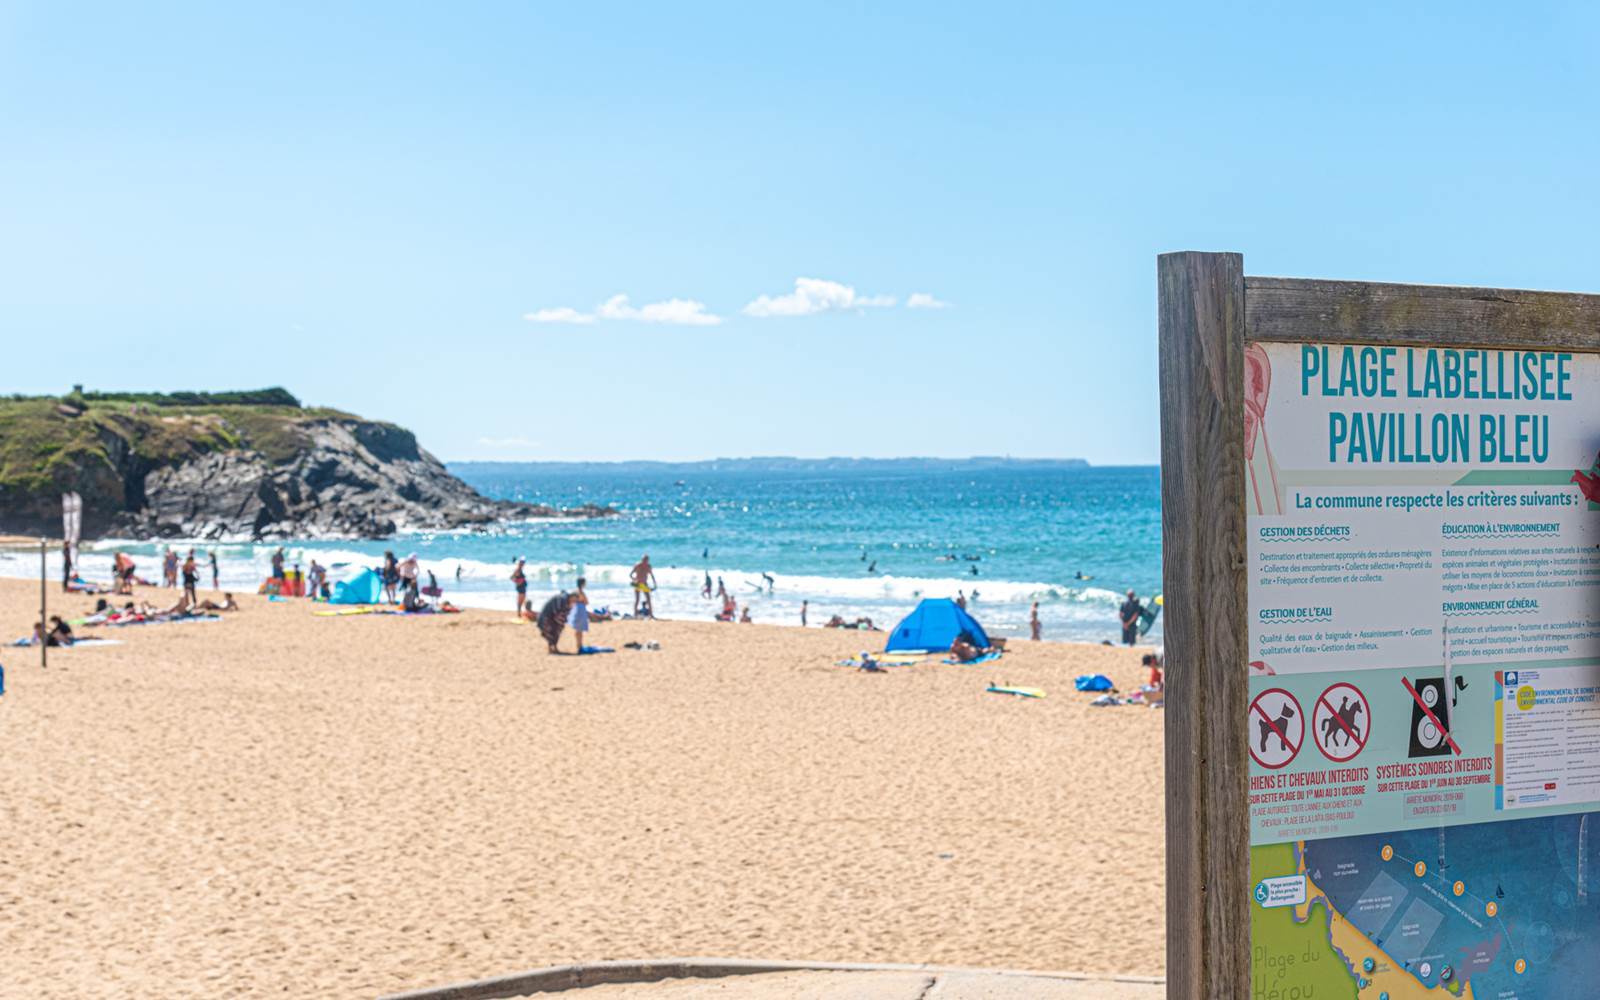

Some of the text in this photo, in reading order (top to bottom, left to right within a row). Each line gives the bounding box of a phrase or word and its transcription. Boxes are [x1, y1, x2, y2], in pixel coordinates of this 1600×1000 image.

[1302, 344, 1397, 398] PLAGE
[1329, 412, 1548, 463] PAVILLON BLEU
[1296, 490, 1572, 512] La commune respecte les critères suivants
[1260, 524, 1350, 537] GESTION DES DÉCHETS
[1442, 522, 1485, 534] ÉDUCATION
[1486, 522, 1492, 533] À
[1304, 552, 1335, 560] traitement
[1336, 551, 1366, 560] appropriés
[1368, 550, 1377, 558] des
[1378, 550, 1400, 558] ordures
[1401, 550, 1432, 560] ménagères
[1290, 564, 1300, 572] des
[1302, 563, 1340, 571] encombrants
[1370, 562, 1395, 570] sélective
[1399, 561, 1423, 571] Propreté
[1424, 560, 1432, 568] du
[1276, 576, 1308, 586] Fréquence
[1461, 571, 1469, 579] les
[1489, 582, 1502, 591] place
[1442, 598, 1539, 611] ENVIRONNEMENT GÉNÉRAL
[1260, 607, 1332, 618] GESTION DE L'EAU
[1260, 634, 1282, 644] Qualité
[1315, 632, 1322, 640] de
[1325, 631, 1352, 642] baignade
[1410, 628, 1432, 636] Gestion
[1260, 647, 1291, 656] qualitative
[1293, 646, 1301, 654] de
[1321, 644, 1344, 652] Gestion
[1345, 643, 1355, 651] des
[1450, 650, 1470, 659] gestion
[1472, 648, 1481, 656] des
[1482, 648, 1503, 657] espaces
[1376, 757, 1492, 780] SYSTÈMES SONORES INTERDITS
[1250, 768, 1369, 790] HIENS ET CHEVAUX INTERDITS
[1378, 774, 1491, 792] SUR CETTE PLAGE DU JUIN AU 30 SEPTEMBRE
[1250, 785, 1365, 804] SUR CETTE PLAGE DU MAI AU 31 OCTOBRE
[1254, 941, 1320, 978] Plage du
